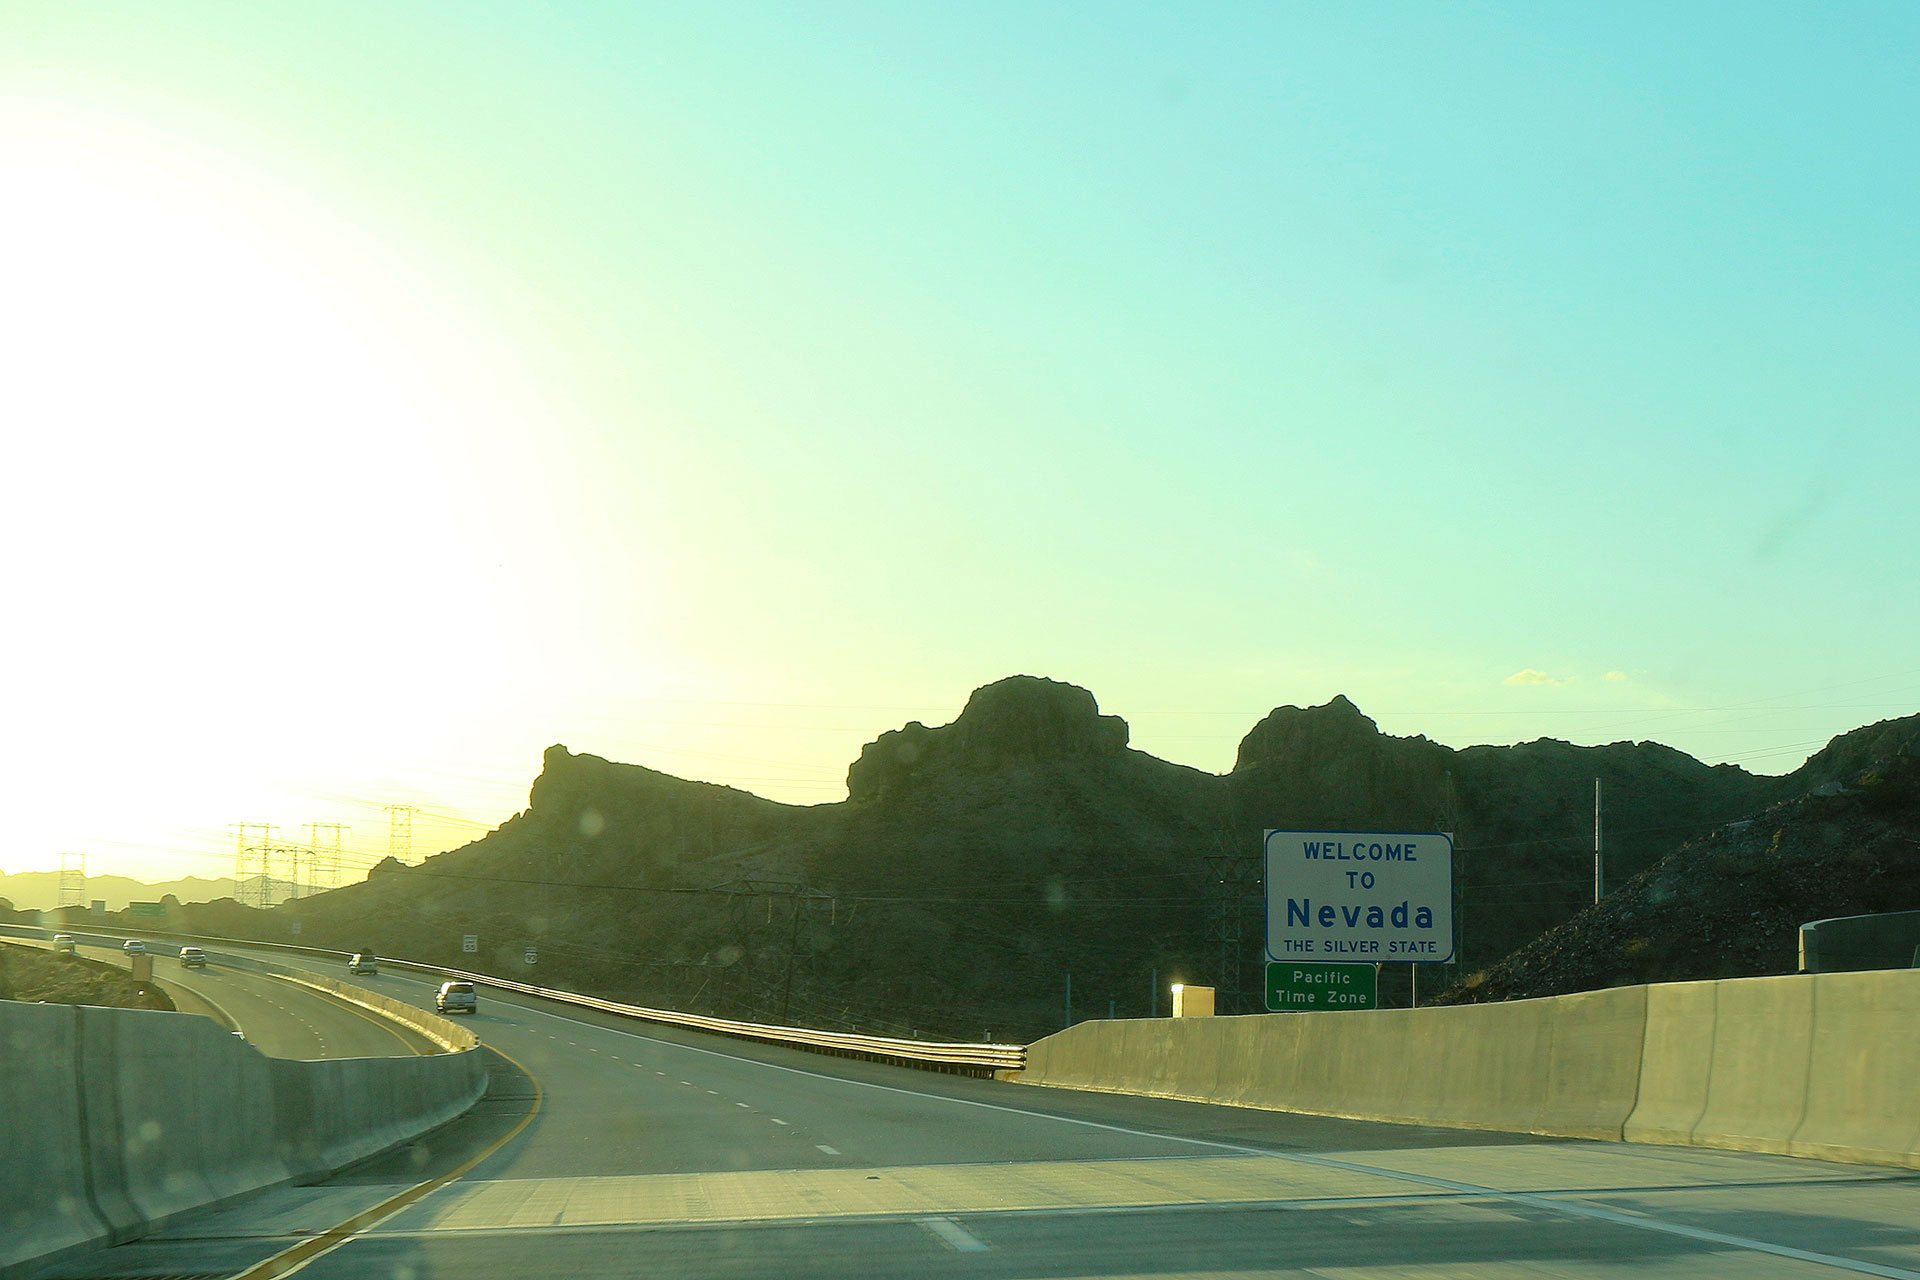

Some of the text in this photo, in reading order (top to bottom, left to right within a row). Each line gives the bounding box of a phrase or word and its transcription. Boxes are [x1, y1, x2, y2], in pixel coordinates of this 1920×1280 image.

[1303, 842, 1417, 861] WELCOME
[1346, 871, 1375, 889] TO
[1287, 899, 1433, 928] Nevada
[1284, 940, 1437, 953] THE SILVER STATE
[1293, 971, 1350, 984] Pacific
[1276, 990, 1367, 1003] Time Zone
